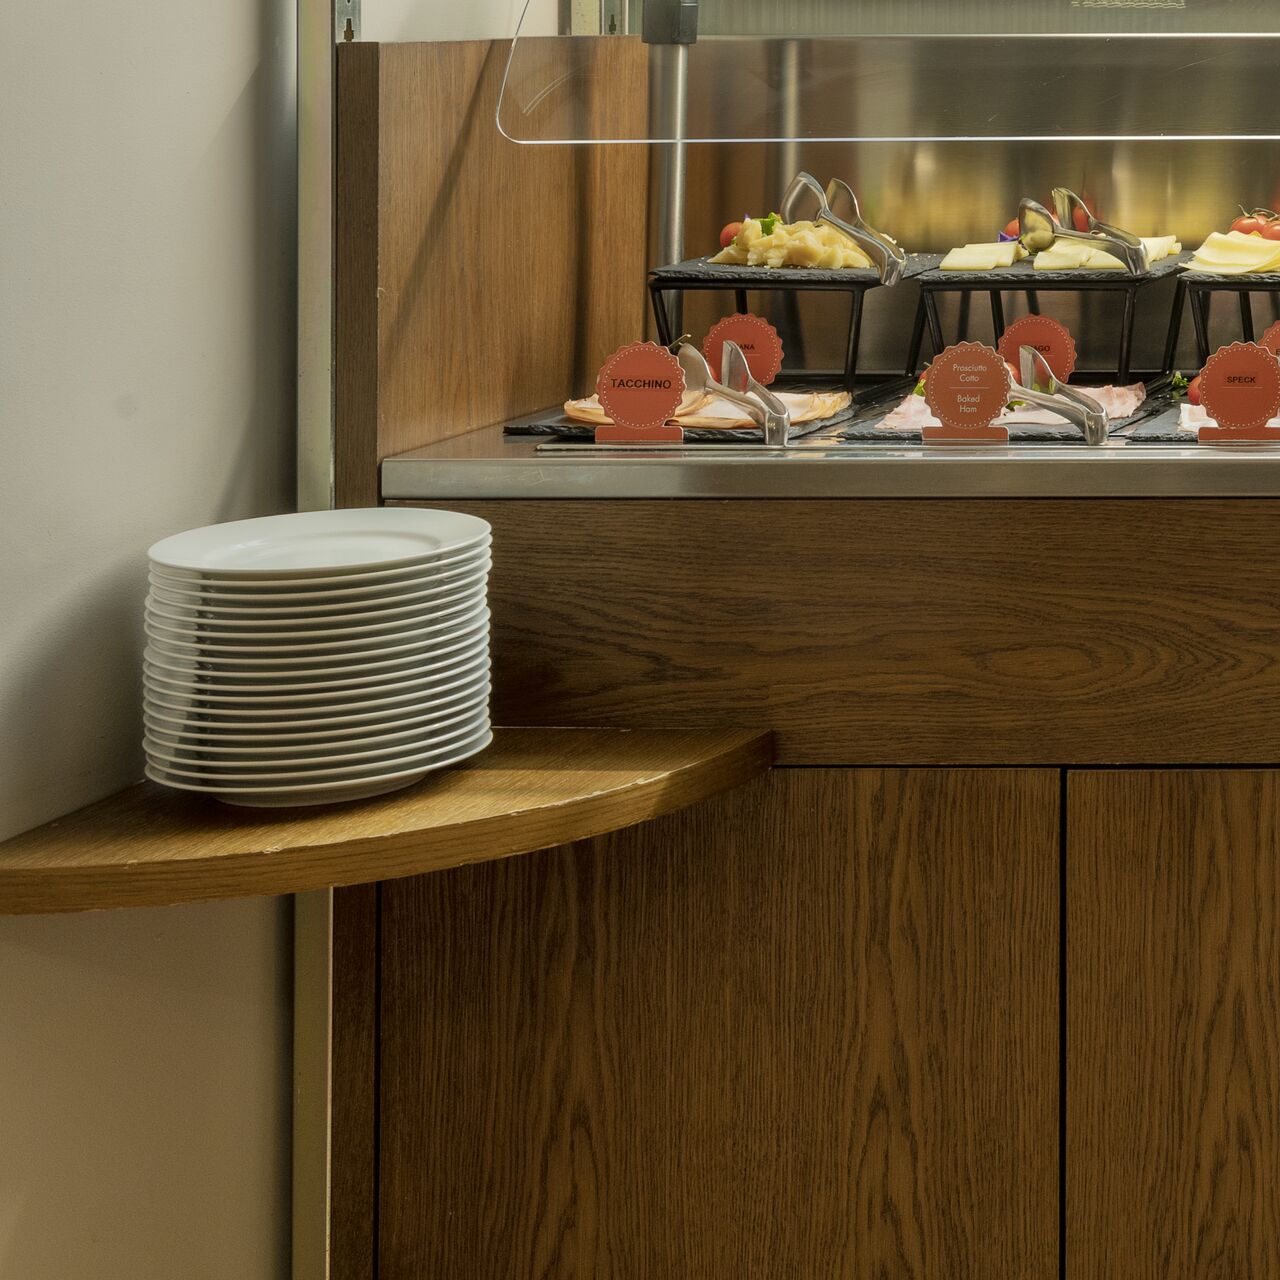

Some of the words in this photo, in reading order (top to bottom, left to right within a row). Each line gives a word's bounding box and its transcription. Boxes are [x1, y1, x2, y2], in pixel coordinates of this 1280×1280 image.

[952, 363, 987, 372] Prosciutto
[959, 374, 980, 382] Cotto
[1226, 376, 1256, 384] SPECK
[611, 378, 672, 390] TACCHINO
[957, 394, 980, 403] Baked
[959, 405, 977, 413] Ham
